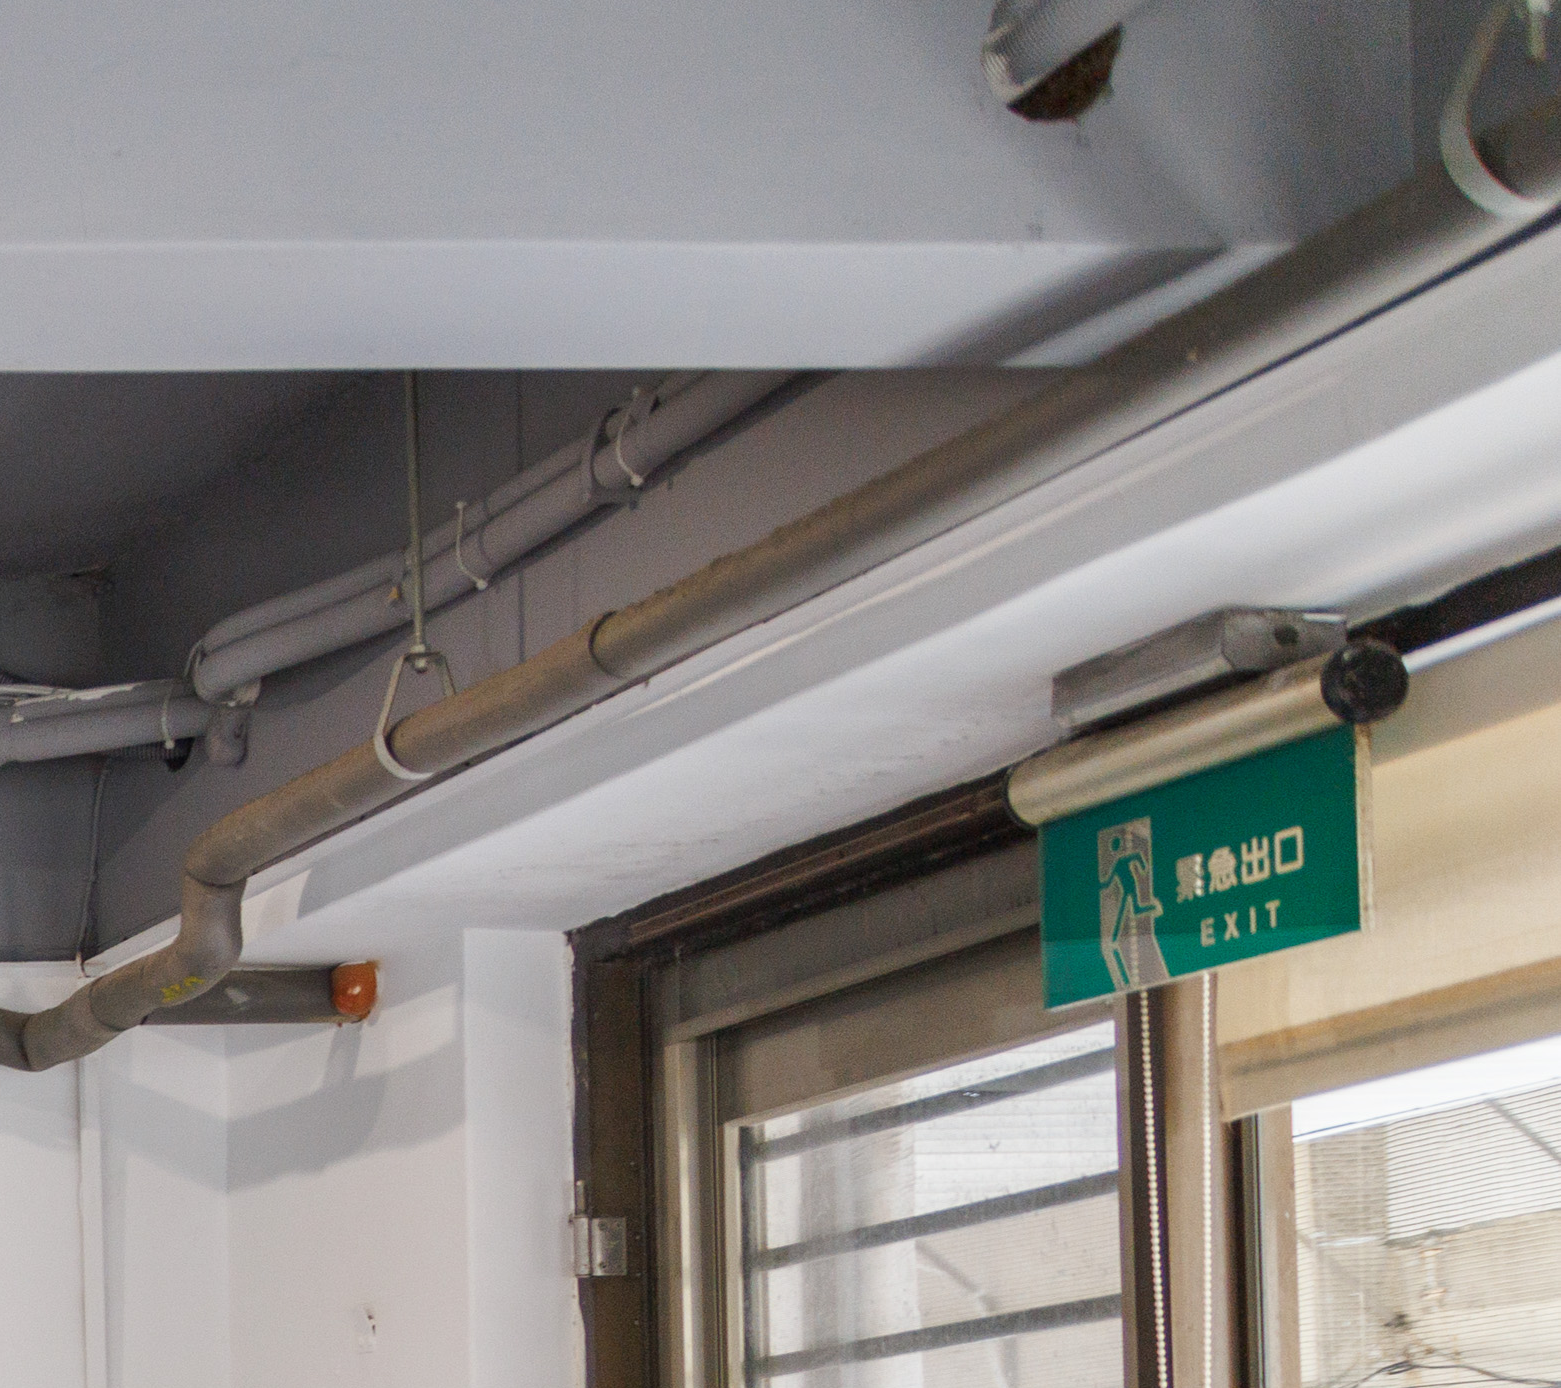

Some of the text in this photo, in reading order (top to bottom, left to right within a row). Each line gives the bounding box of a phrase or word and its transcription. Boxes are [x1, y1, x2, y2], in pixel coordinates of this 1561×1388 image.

[1175, 826, 1304, 902] 緊急出口
[1201, 900, 1282, 946] EXIT
